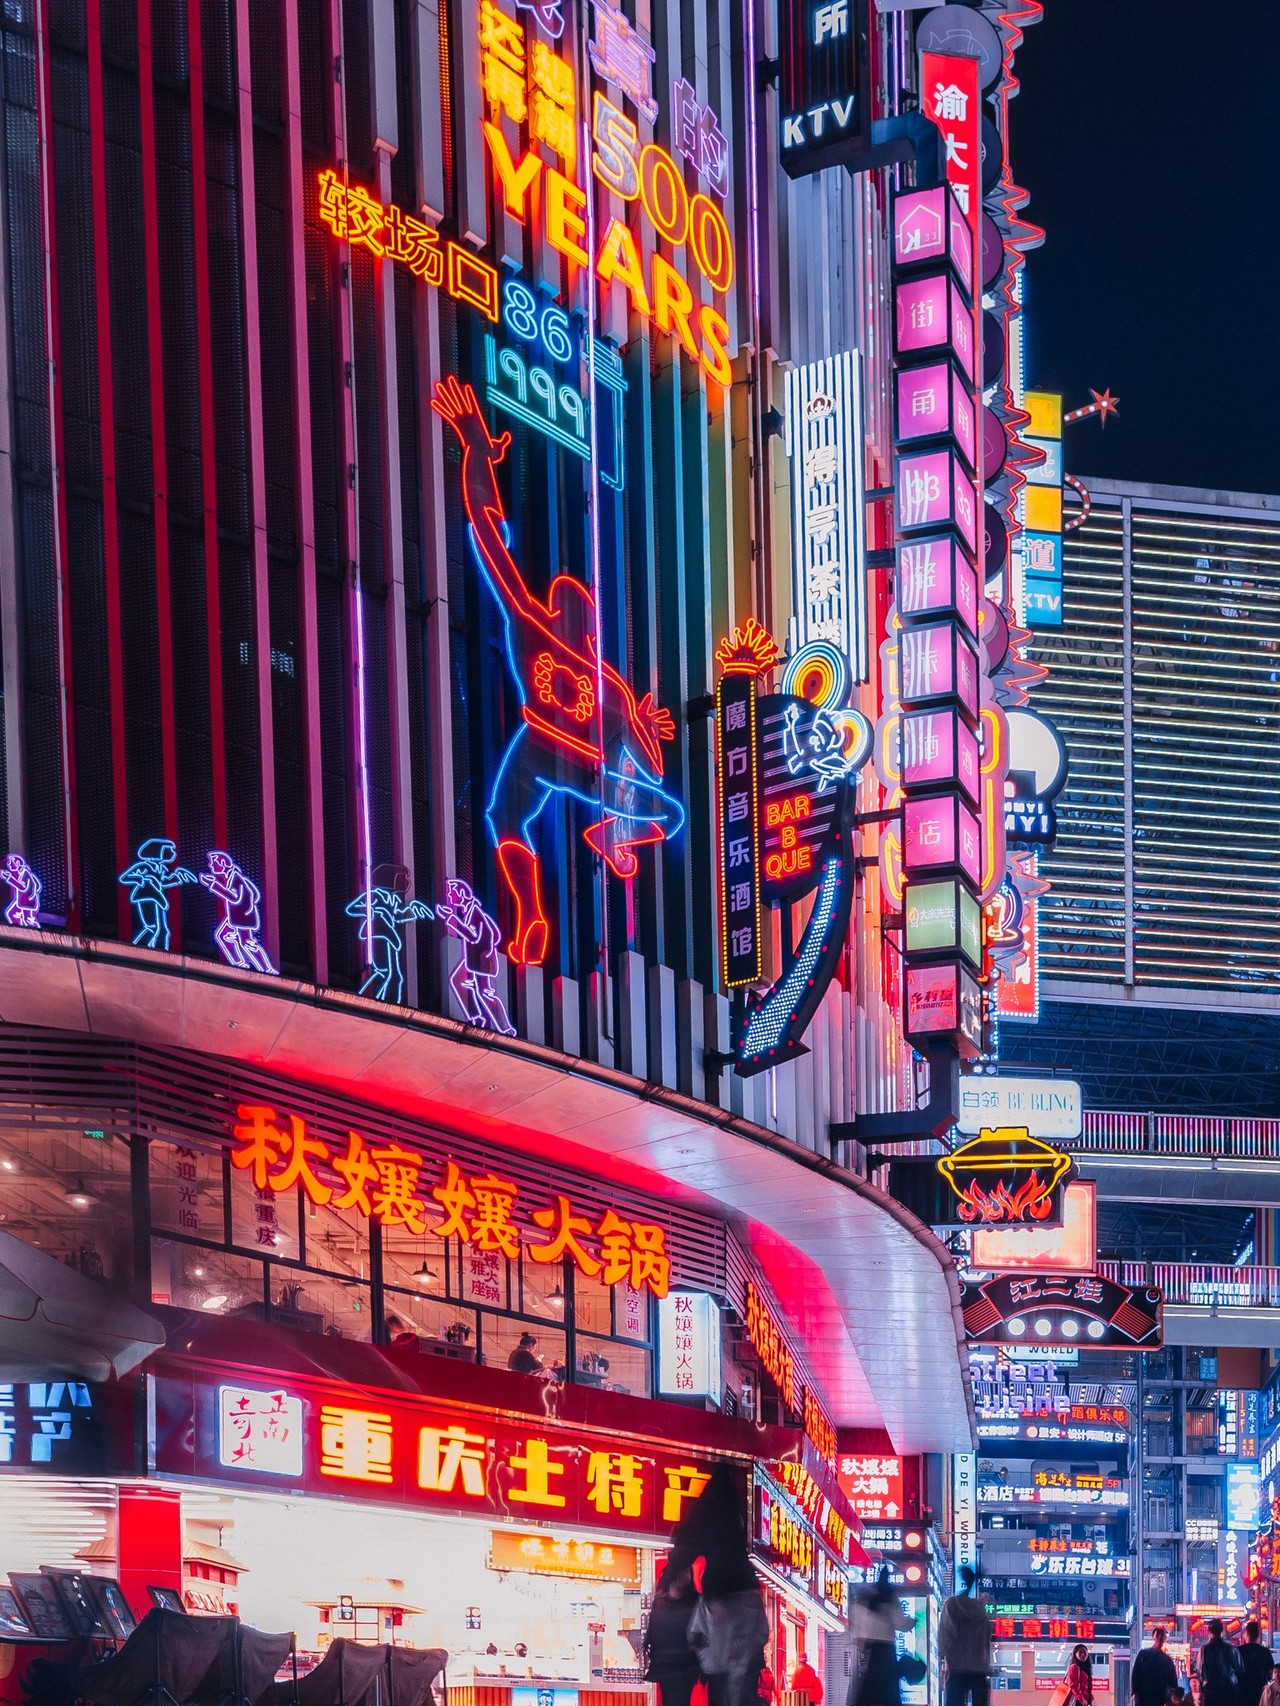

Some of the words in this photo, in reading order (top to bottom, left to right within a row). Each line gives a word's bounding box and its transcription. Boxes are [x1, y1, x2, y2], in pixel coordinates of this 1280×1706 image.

[783, 96, 854, 148] KTV
[594, 91, 733, 292] 500
[482, 118, 733, 388] YEARS
[485, 334, 585, 438] 1999
[1021, 593, 1061, 611] KTV
[766, 795, 810, 827] BAR
[726, 700, 753, 957] 魔方音乐酒馆
[781, 826, 796, 848] B
[765, 846, 811, 880] QUE
[920, 907, 955, 920] 大米先生
[963, 1091, 1000, 1108] 白领
[1007, 1091, 1027, 1110] BE
[1030, 1092, 1074, 1111] BLING
[1028, 1346, 1075, 1355] WORLD
[1114, 1433, 1126, 1443] 5F
[320, 1404, 713, 1522] 重庆土特产
[1106, 1478, 1120, 1488] 5F
[960, 1520, 969, 1565] WORLD
[1047, 1556, 1114, 1576] 乐乐台球
[977, 1578, 1050, 1589] 洛特走廊咖啡
[994, 1618, 1095, 1639] 得意潮馆
